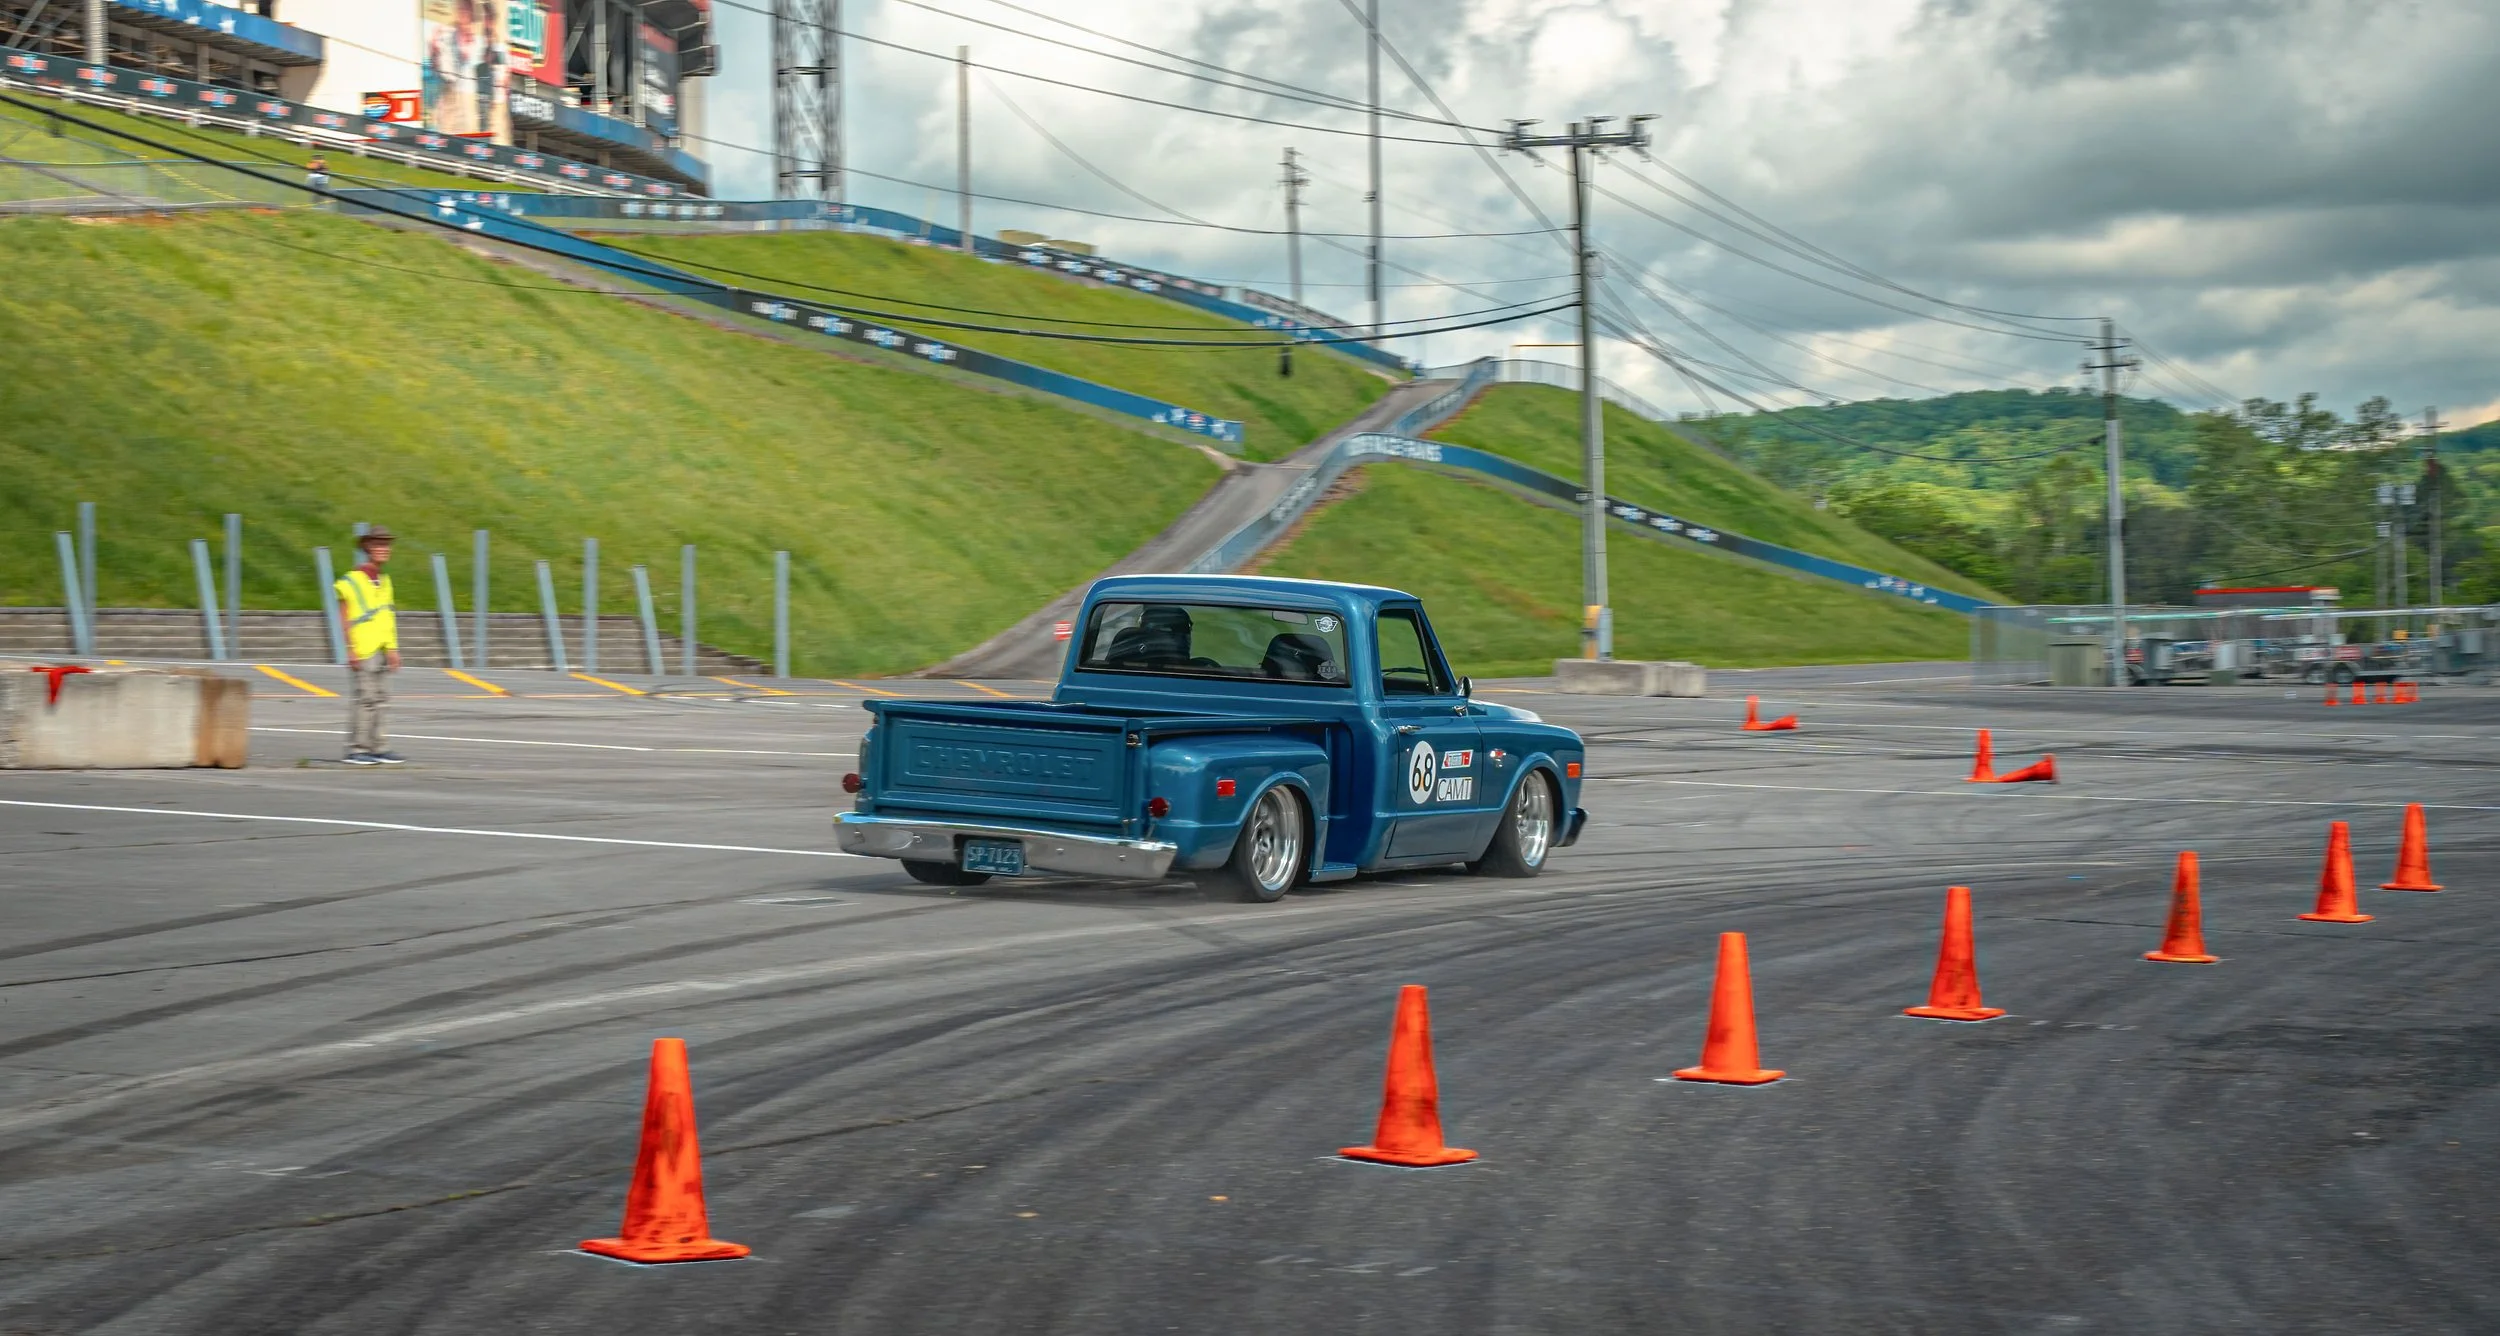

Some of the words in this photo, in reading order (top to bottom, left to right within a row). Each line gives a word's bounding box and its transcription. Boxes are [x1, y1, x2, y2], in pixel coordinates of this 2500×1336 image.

[915, 744, 1095, 782] CHEVROLET
[1412, 752, 1434, 793] 68
[1437, 778, 1472, 801] CAMT
